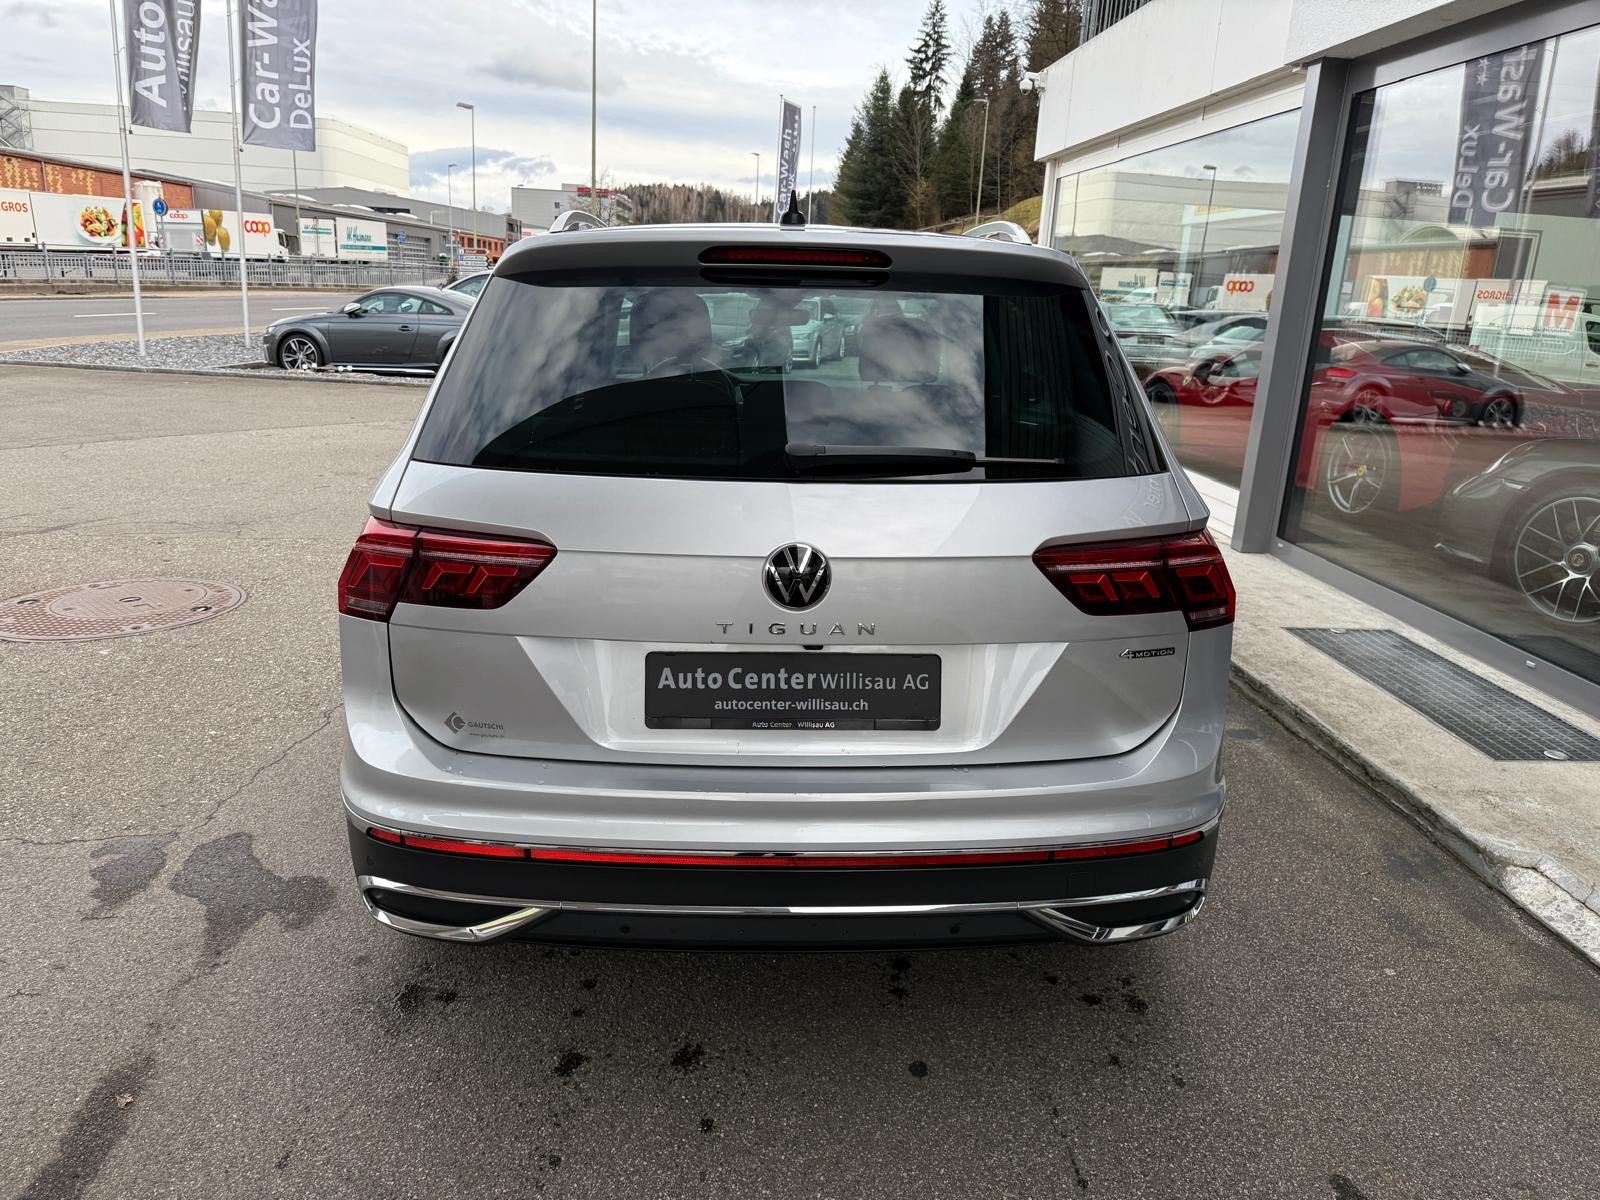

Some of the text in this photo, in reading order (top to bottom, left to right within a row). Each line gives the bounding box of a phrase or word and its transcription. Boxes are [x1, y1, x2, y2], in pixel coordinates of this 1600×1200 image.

[133, 2, 168, 108] Auto
[288, 38, 313, 130] DeLux
[244, 220, 271, 237] coop
[716, 622, 877, 636] TIGUAN
[1120, 648, 1174, 659] 4MOTION
[657, 667, 929, 690] Auto Center Willisau AG
[714, 699, 869, 711] autocenter-willisau.ch
[752, 721, 769, 729] Auto
[825, 721, 835, 729] AG
